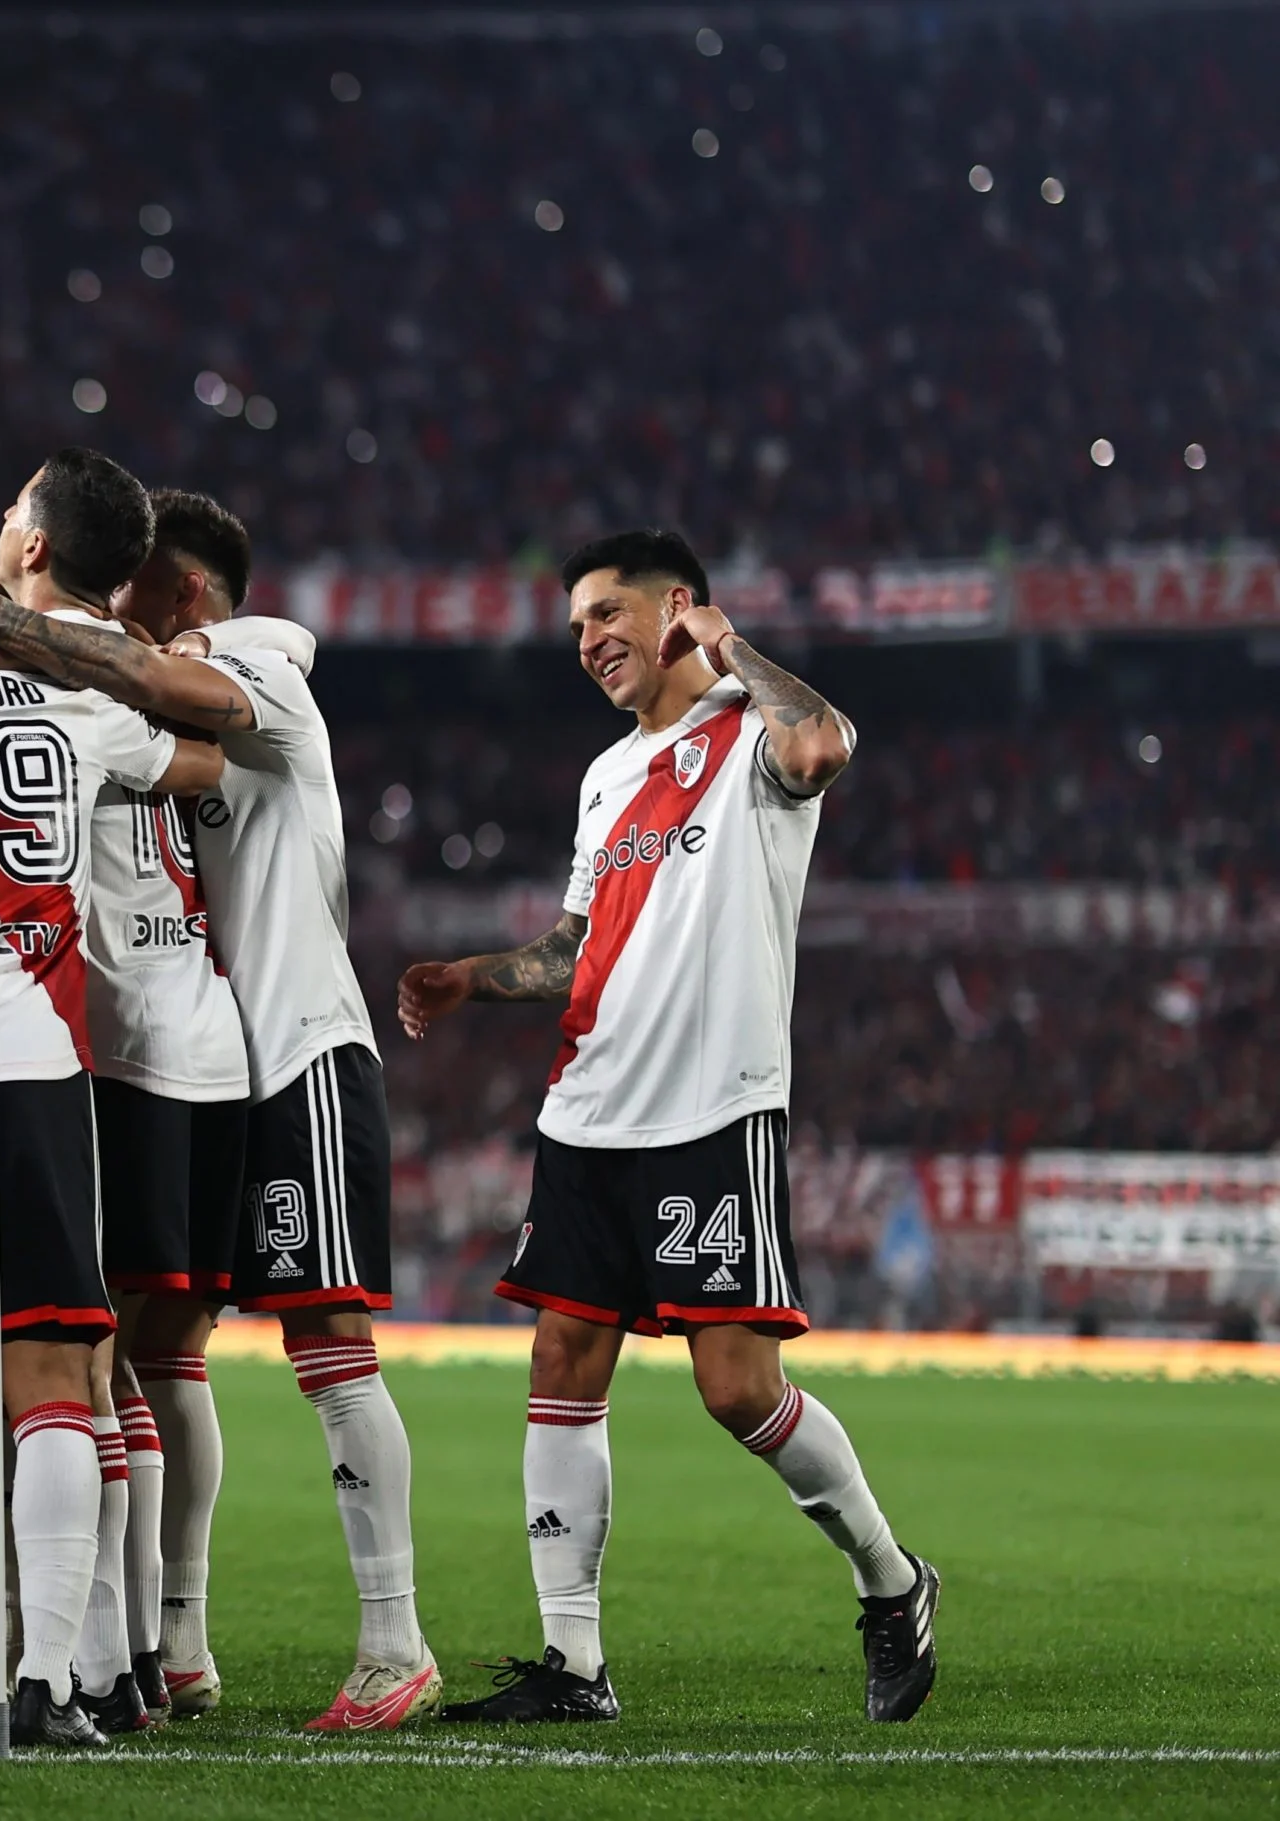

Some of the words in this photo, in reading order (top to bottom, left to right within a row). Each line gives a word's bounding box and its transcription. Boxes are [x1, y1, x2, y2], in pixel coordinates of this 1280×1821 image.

[590, 824, 707, 888] odere
[131, 913, 207, 948] DIREC
[246, 1179, 309, 1253] 13
[655, 1194, 746, 1264] 24
[267, 1267, 305, 1279] adidas
[702, 1280, 742, 1293] adidas
